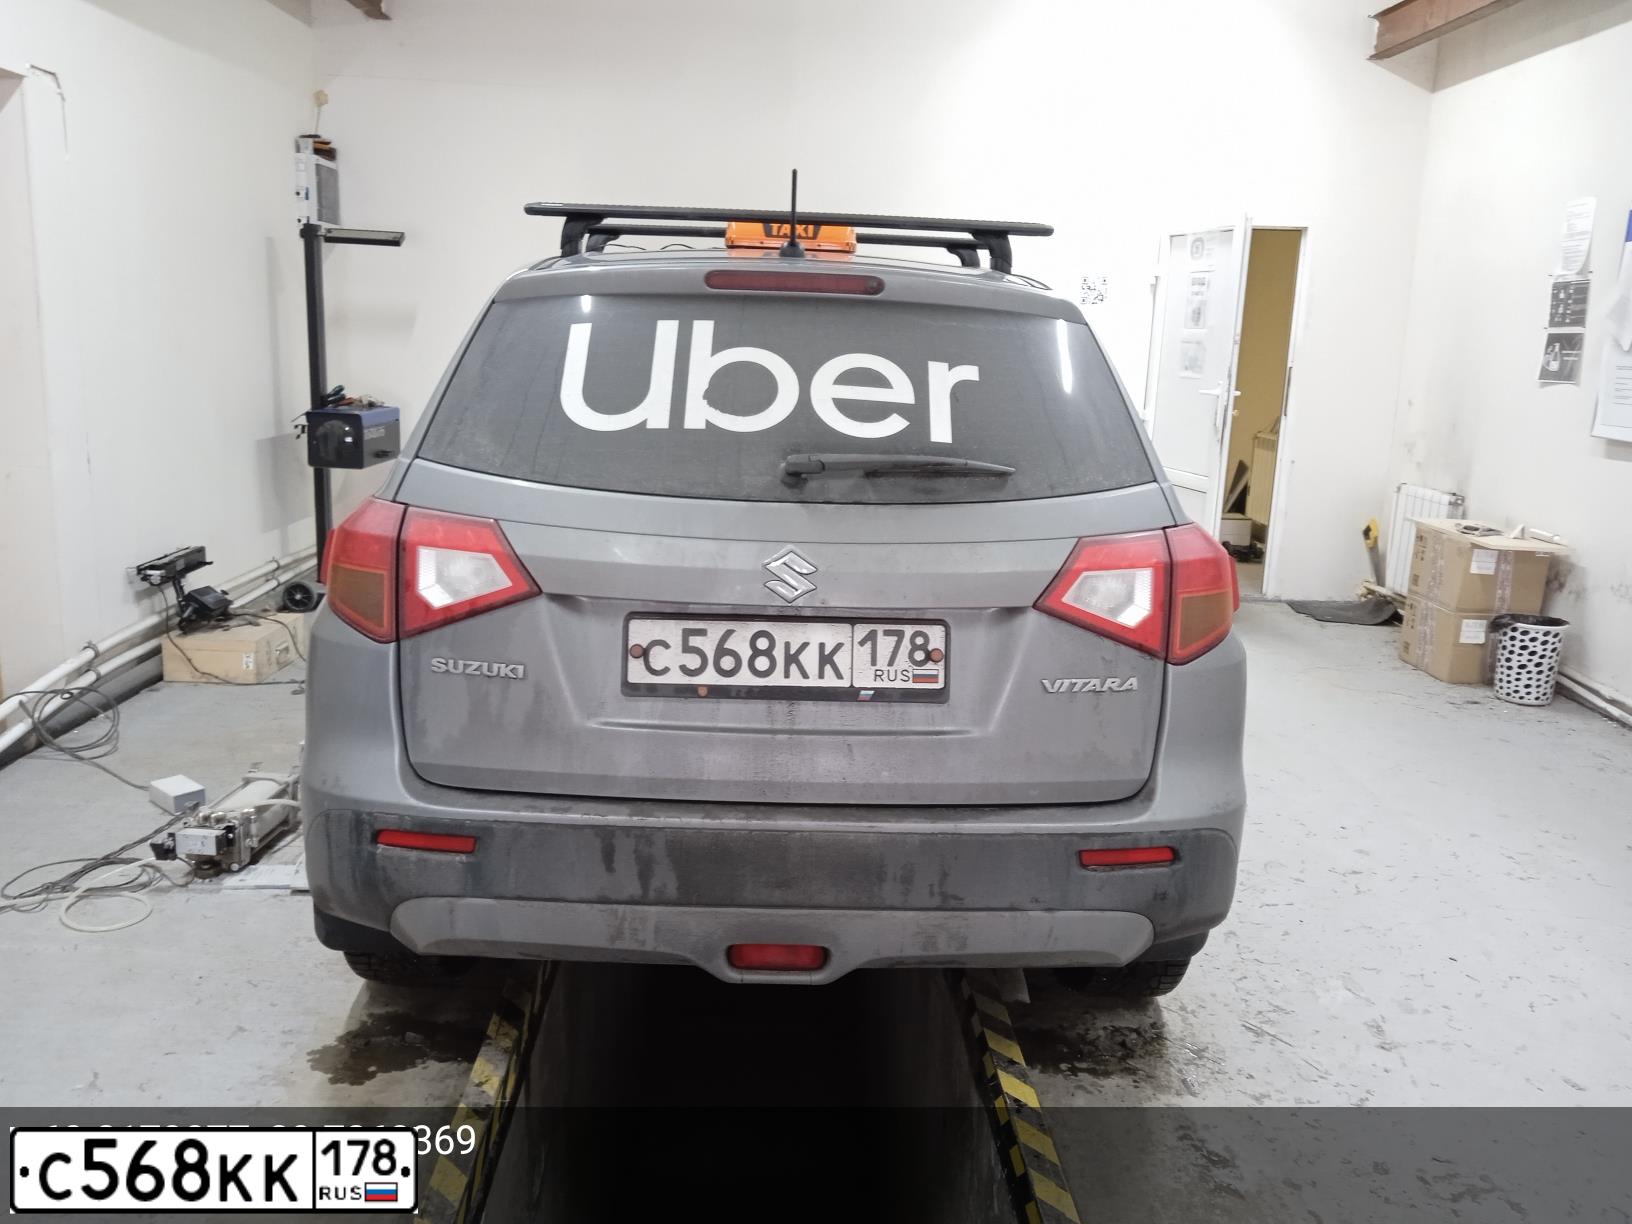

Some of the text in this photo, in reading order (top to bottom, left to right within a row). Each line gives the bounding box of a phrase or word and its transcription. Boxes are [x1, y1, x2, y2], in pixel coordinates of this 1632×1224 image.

[560, 319, 980, 444] Uber
[643, 627, 931, 680] C568KK 178
[431, 657, 525, 679] SUZUKI
[873, 669, 910, 682] RUS
[1041, 676, 1138, 693] VITARA
